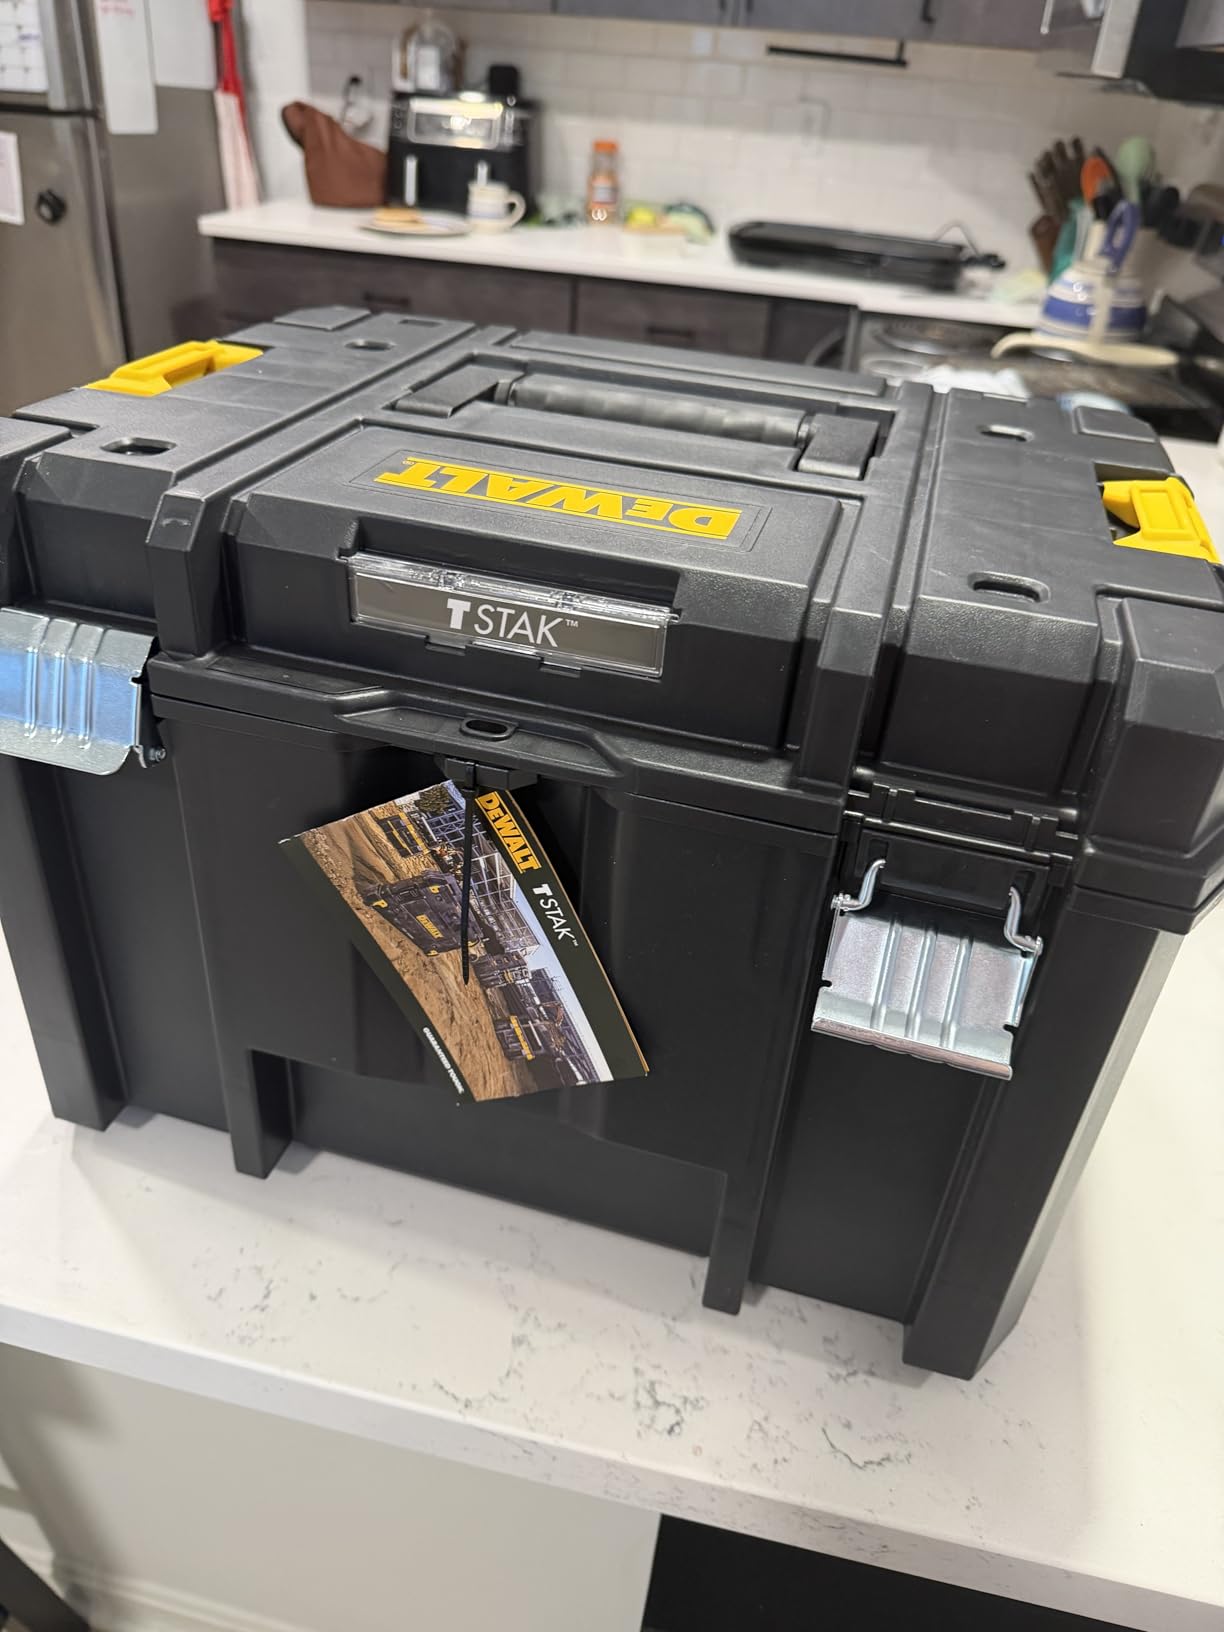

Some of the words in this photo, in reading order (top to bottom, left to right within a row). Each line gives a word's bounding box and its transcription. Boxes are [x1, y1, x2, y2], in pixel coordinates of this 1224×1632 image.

[374, 457, 742, 541] DEWALT
[446, 598, 471, 630] T
[475, 791, 542, 874] DEWALT
